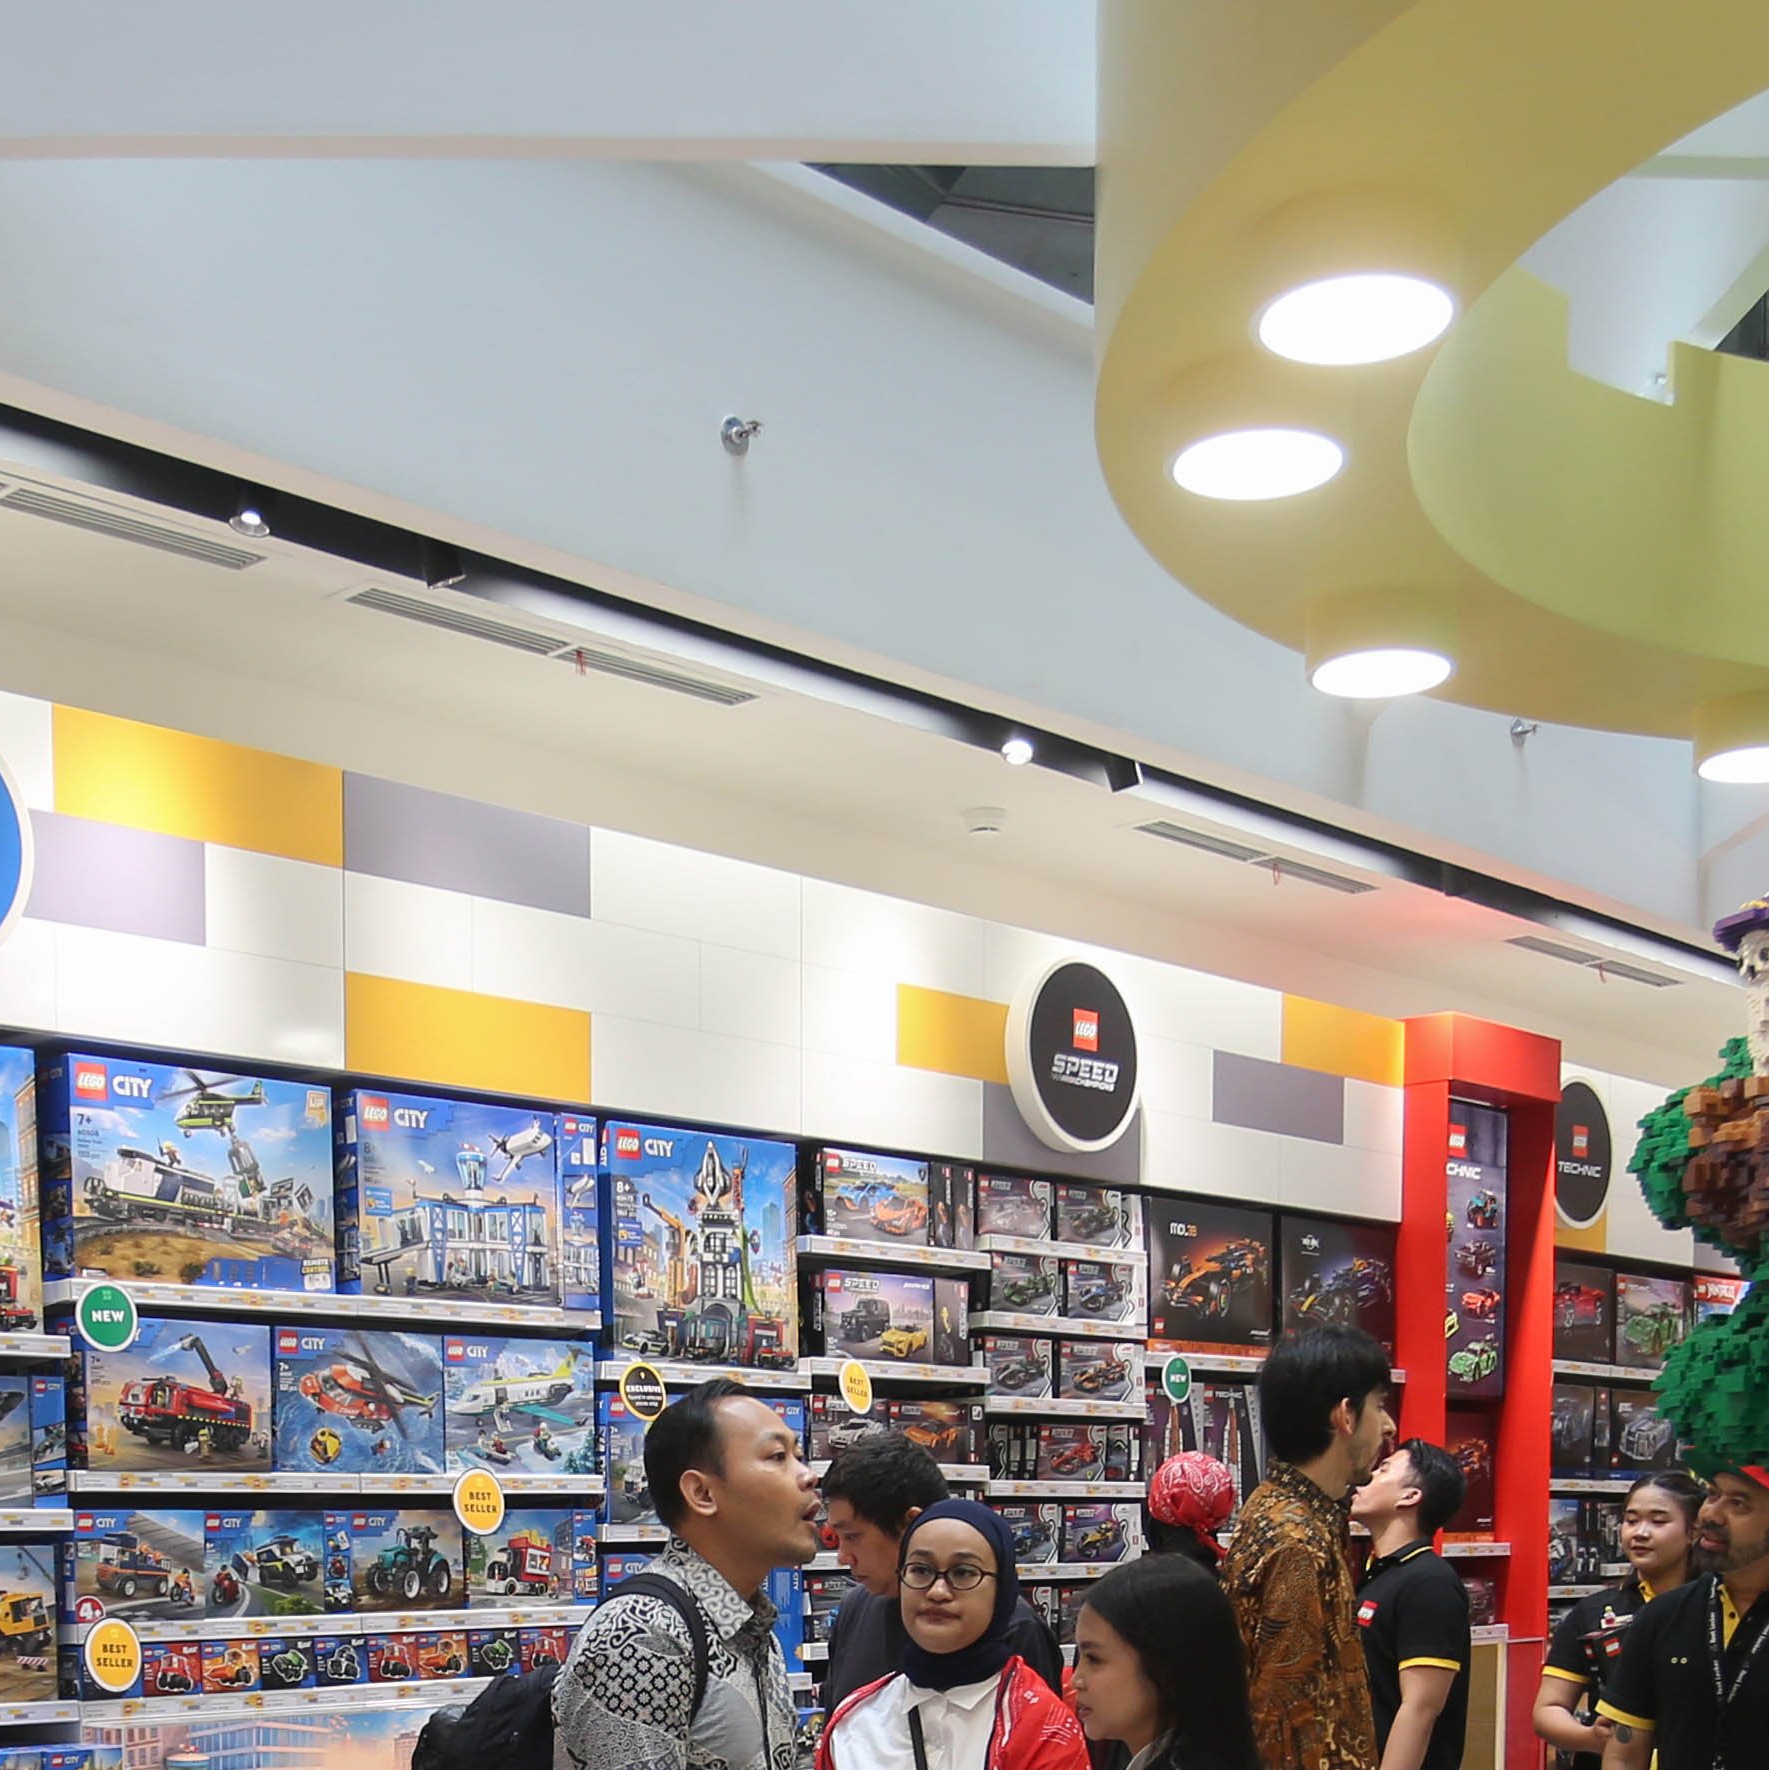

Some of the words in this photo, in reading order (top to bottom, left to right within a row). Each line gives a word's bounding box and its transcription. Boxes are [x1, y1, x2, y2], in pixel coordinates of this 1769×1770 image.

[1074, 1019, 1098, 1039] LEGO
[1051, 1053, 1119, 1084] SPEED
[76, 1072, 106, 1090] LEGO
[112, 1074, 153, 1099] CITY
[77, 1113, 93, 1128] 7+
[363, 1105, 388, 1121] LEGO
[393, 1107, 429, 1129] CITY
[616, 1134, 640, 1151] LEGO
[645, 1137, 674, 1158] CITY
[1448, 1134, 1466, 1147] LEGO
[842, 1158, 878, 1174] SPEED
[1446, 1162, 1482, 1180] CHNIC
[1557, 1161, 1602, 1178] TECHNIC
[616, 1180, 631, 1193] 8+
[844, 1277, 880, 1292] SPEED
[91, 1310, 125, 1323] NEW
[301, 1337, 325, 1350] CITY
[467, 1345, 489, 1358] CITY
[625, 1384, 662, 1394] EXCLUSIVE
[469, 1492, 492, 1501] BEST
[464, 1503, 497, 1514] SELLER
[96, 1518, 117, 1529] CITY
[223, 1518, 242, 1529] CITY
[369, 1516, 386, 1527] CITY
[78, 1601, 102, 1619] 4+
[102, 1644, 127, 1654] BEST
[96, 1657, 134, 1668] SELLER
